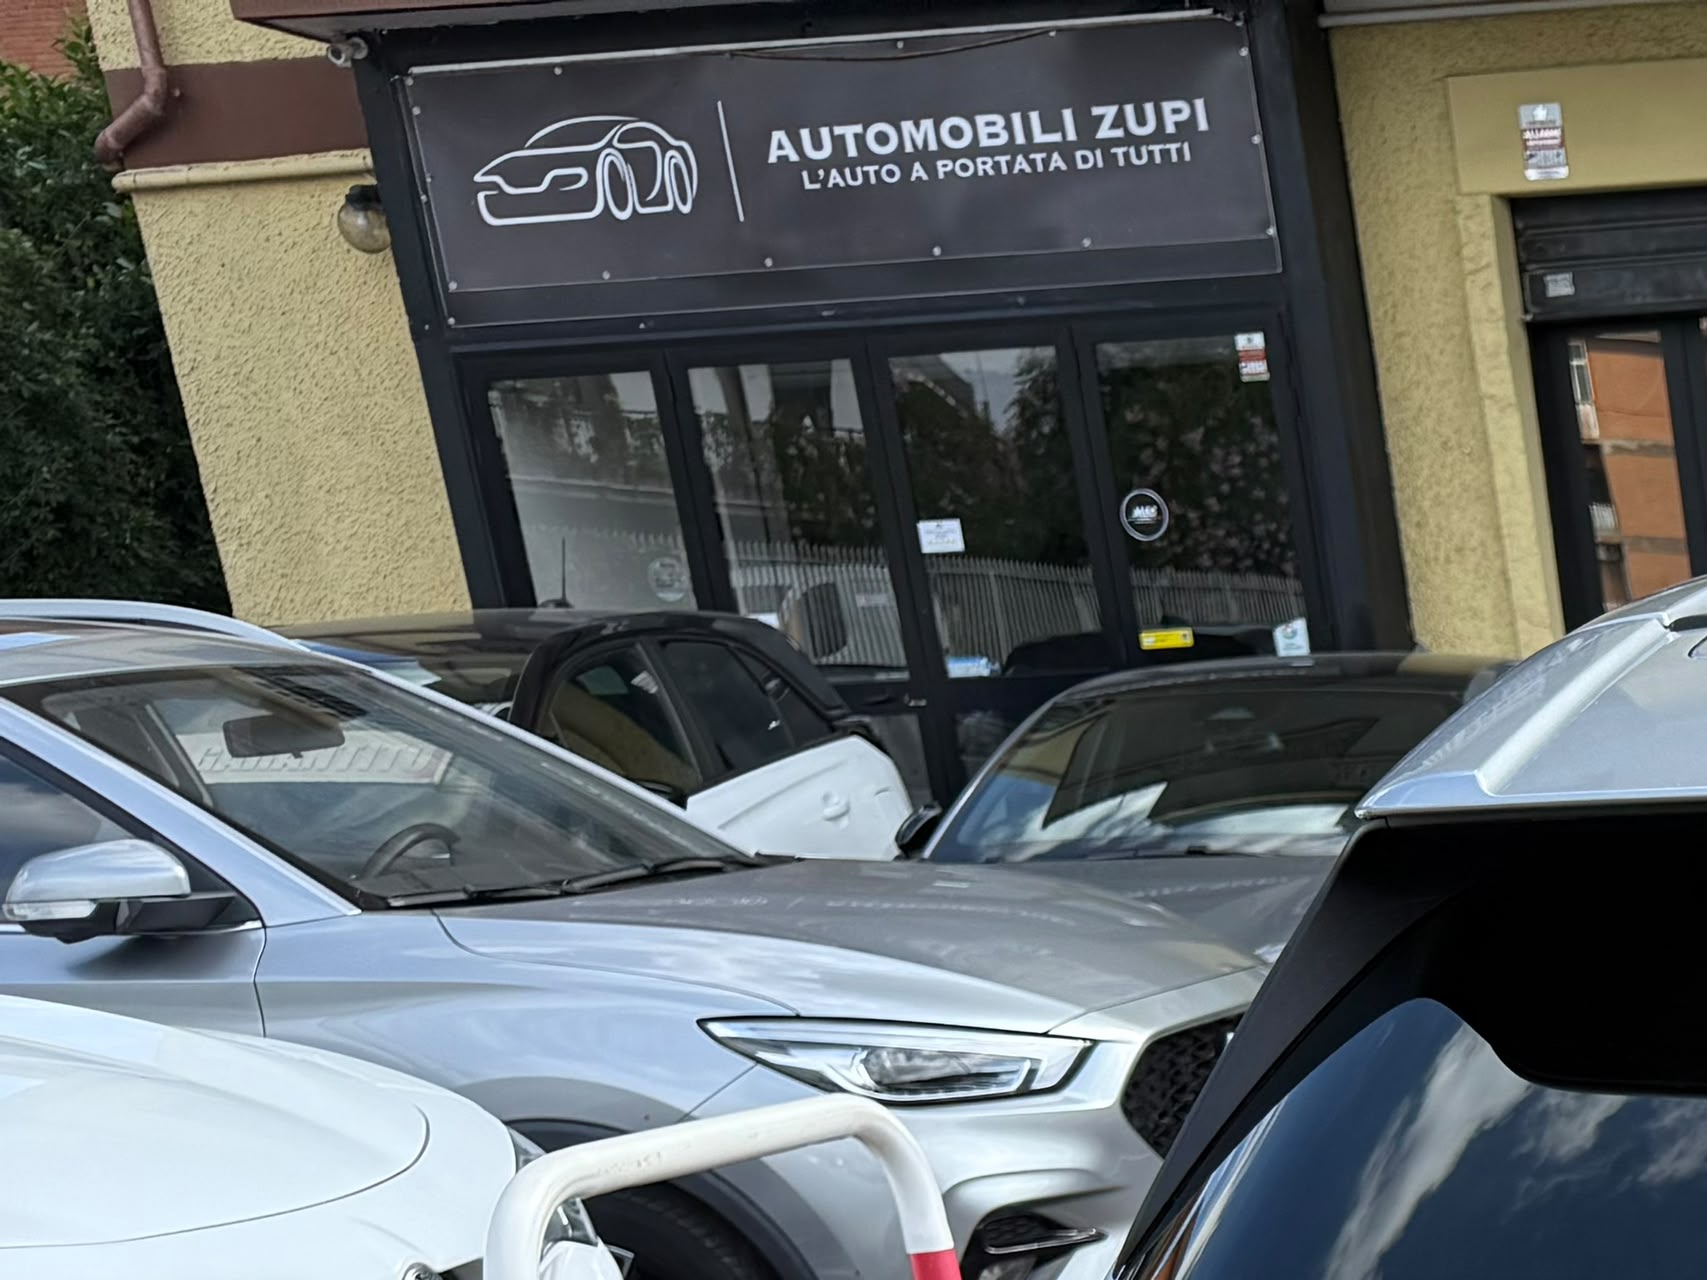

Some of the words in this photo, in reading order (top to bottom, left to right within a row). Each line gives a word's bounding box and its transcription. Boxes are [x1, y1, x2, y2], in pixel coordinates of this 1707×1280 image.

[768, 108, 1077, 164] AUTOMOBILI
[1091, 98, 1209, 140] ZUPI
[802, 163, 901, 190] L'AUTO
[910, 164, 928, 181] A
[937, 152, 1067, 179] PORTATA
[1076, 148, 1103, 169] DI
[1111, 142, 1192, 166] TUTTI
